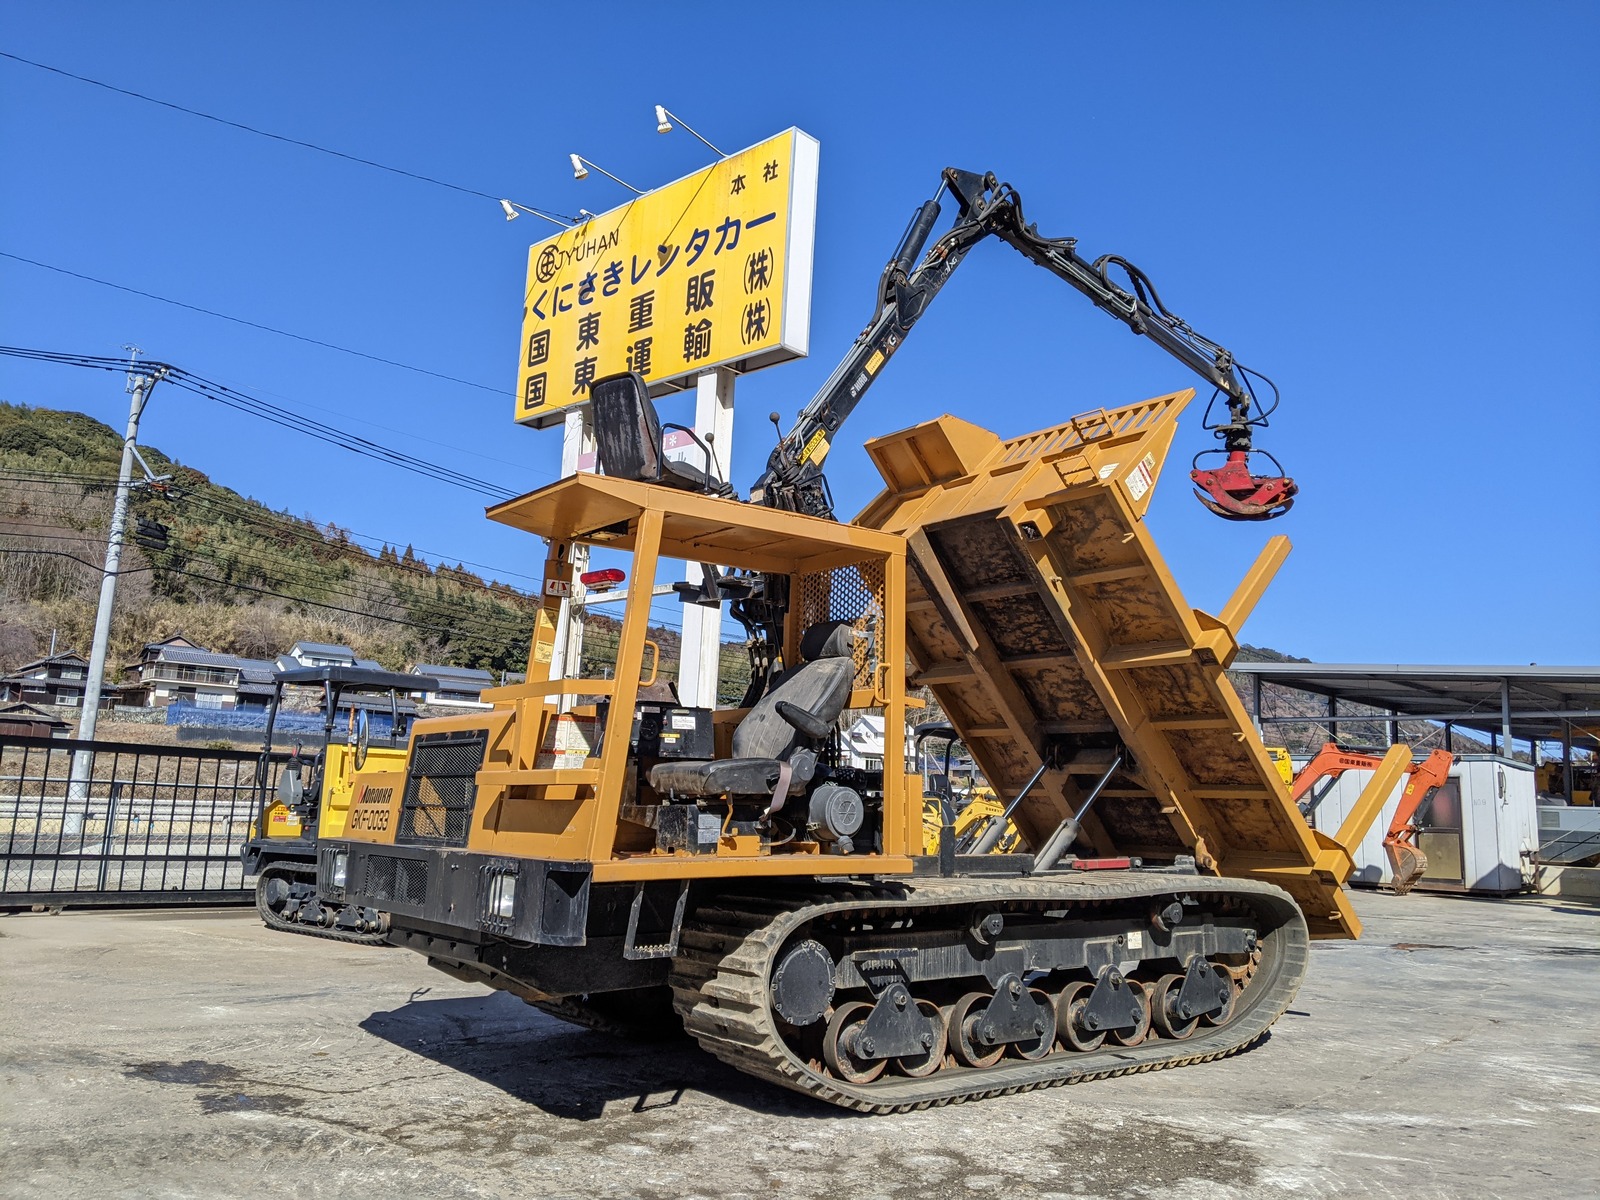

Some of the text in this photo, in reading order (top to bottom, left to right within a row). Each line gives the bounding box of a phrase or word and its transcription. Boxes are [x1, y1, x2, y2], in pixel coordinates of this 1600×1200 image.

[531, 211, 777, 321] くにさきレンタカー
[554, 227, 619, 271] JYUHAN
[351, 809, 390, 831] GKF-0033
